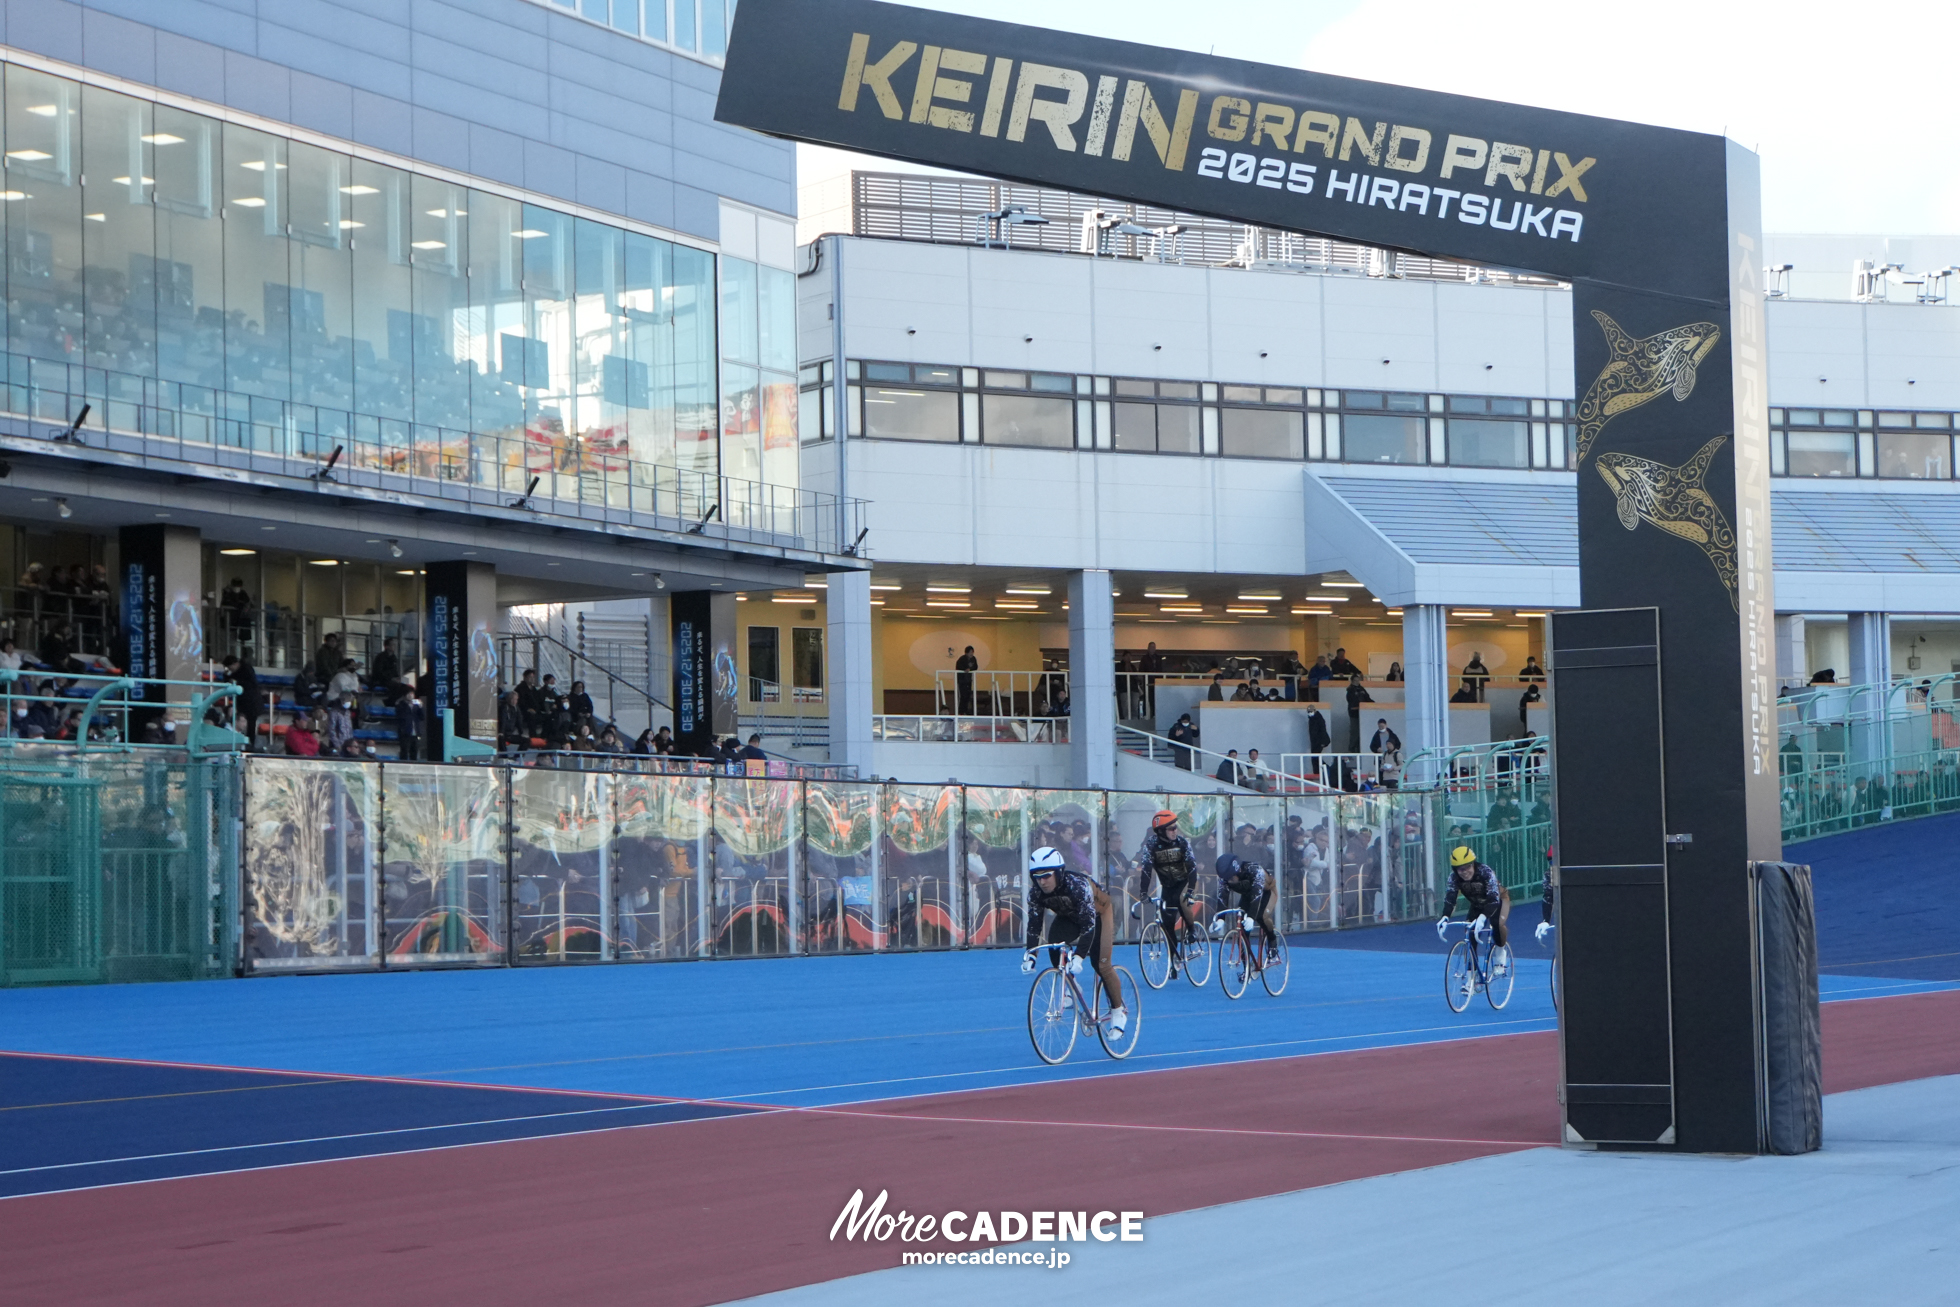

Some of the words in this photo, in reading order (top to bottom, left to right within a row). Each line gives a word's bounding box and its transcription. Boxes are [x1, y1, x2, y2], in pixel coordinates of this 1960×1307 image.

[838, 32, 1199, 171] KEIRIN
[1206, 96, 1431, 174] GRAND
[1440, 134, 1597, 203] PRIX
[1198, 147, 1317, 194] 2025
[1325, 169, 1583, 243] HIRATSUKA
[1737, 231, 1761, 499] KEIRIN
[1745, 507, 1755, 591] 2025
[1754, 509, 1767, 666] GRAND
[1748, 599, 1761, 775] HIRATSUKA
[1758, 675, 1771, 776] PRIX
